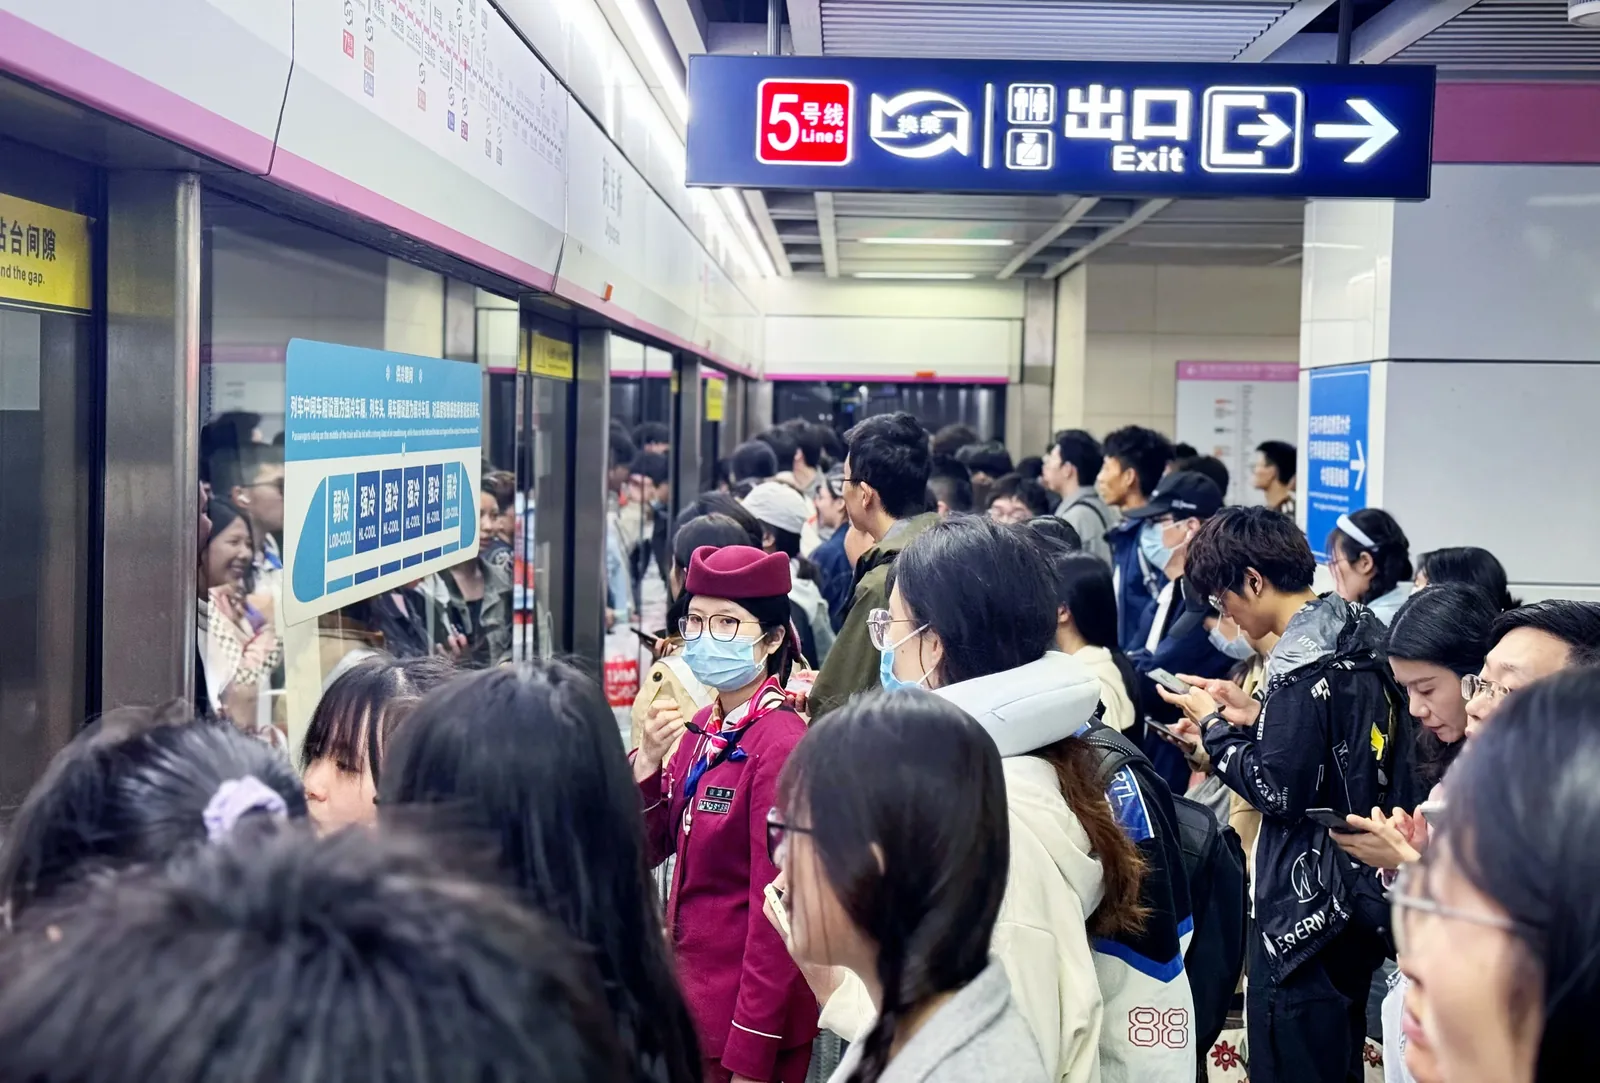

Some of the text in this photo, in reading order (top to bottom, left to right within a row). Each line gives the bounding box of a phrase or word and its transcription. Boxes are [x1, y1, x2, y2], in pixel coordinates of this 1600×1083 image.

[897, 114, 943, 134] 换乘
[1064, 84, 1190, 141] 出口
[1112, 145, 1184, 172] Exit
[13, 265, 26, 281] the
[28, 271, 45, 287] gap.
[360, 483, 376, 518] 强冷
[385, 480, 399, 514] 强冷
[407, 477, 420, 509] 强冷
[428, 474, 440, 505] 强冷
[1128, 1006, 1189, 1049] 88
